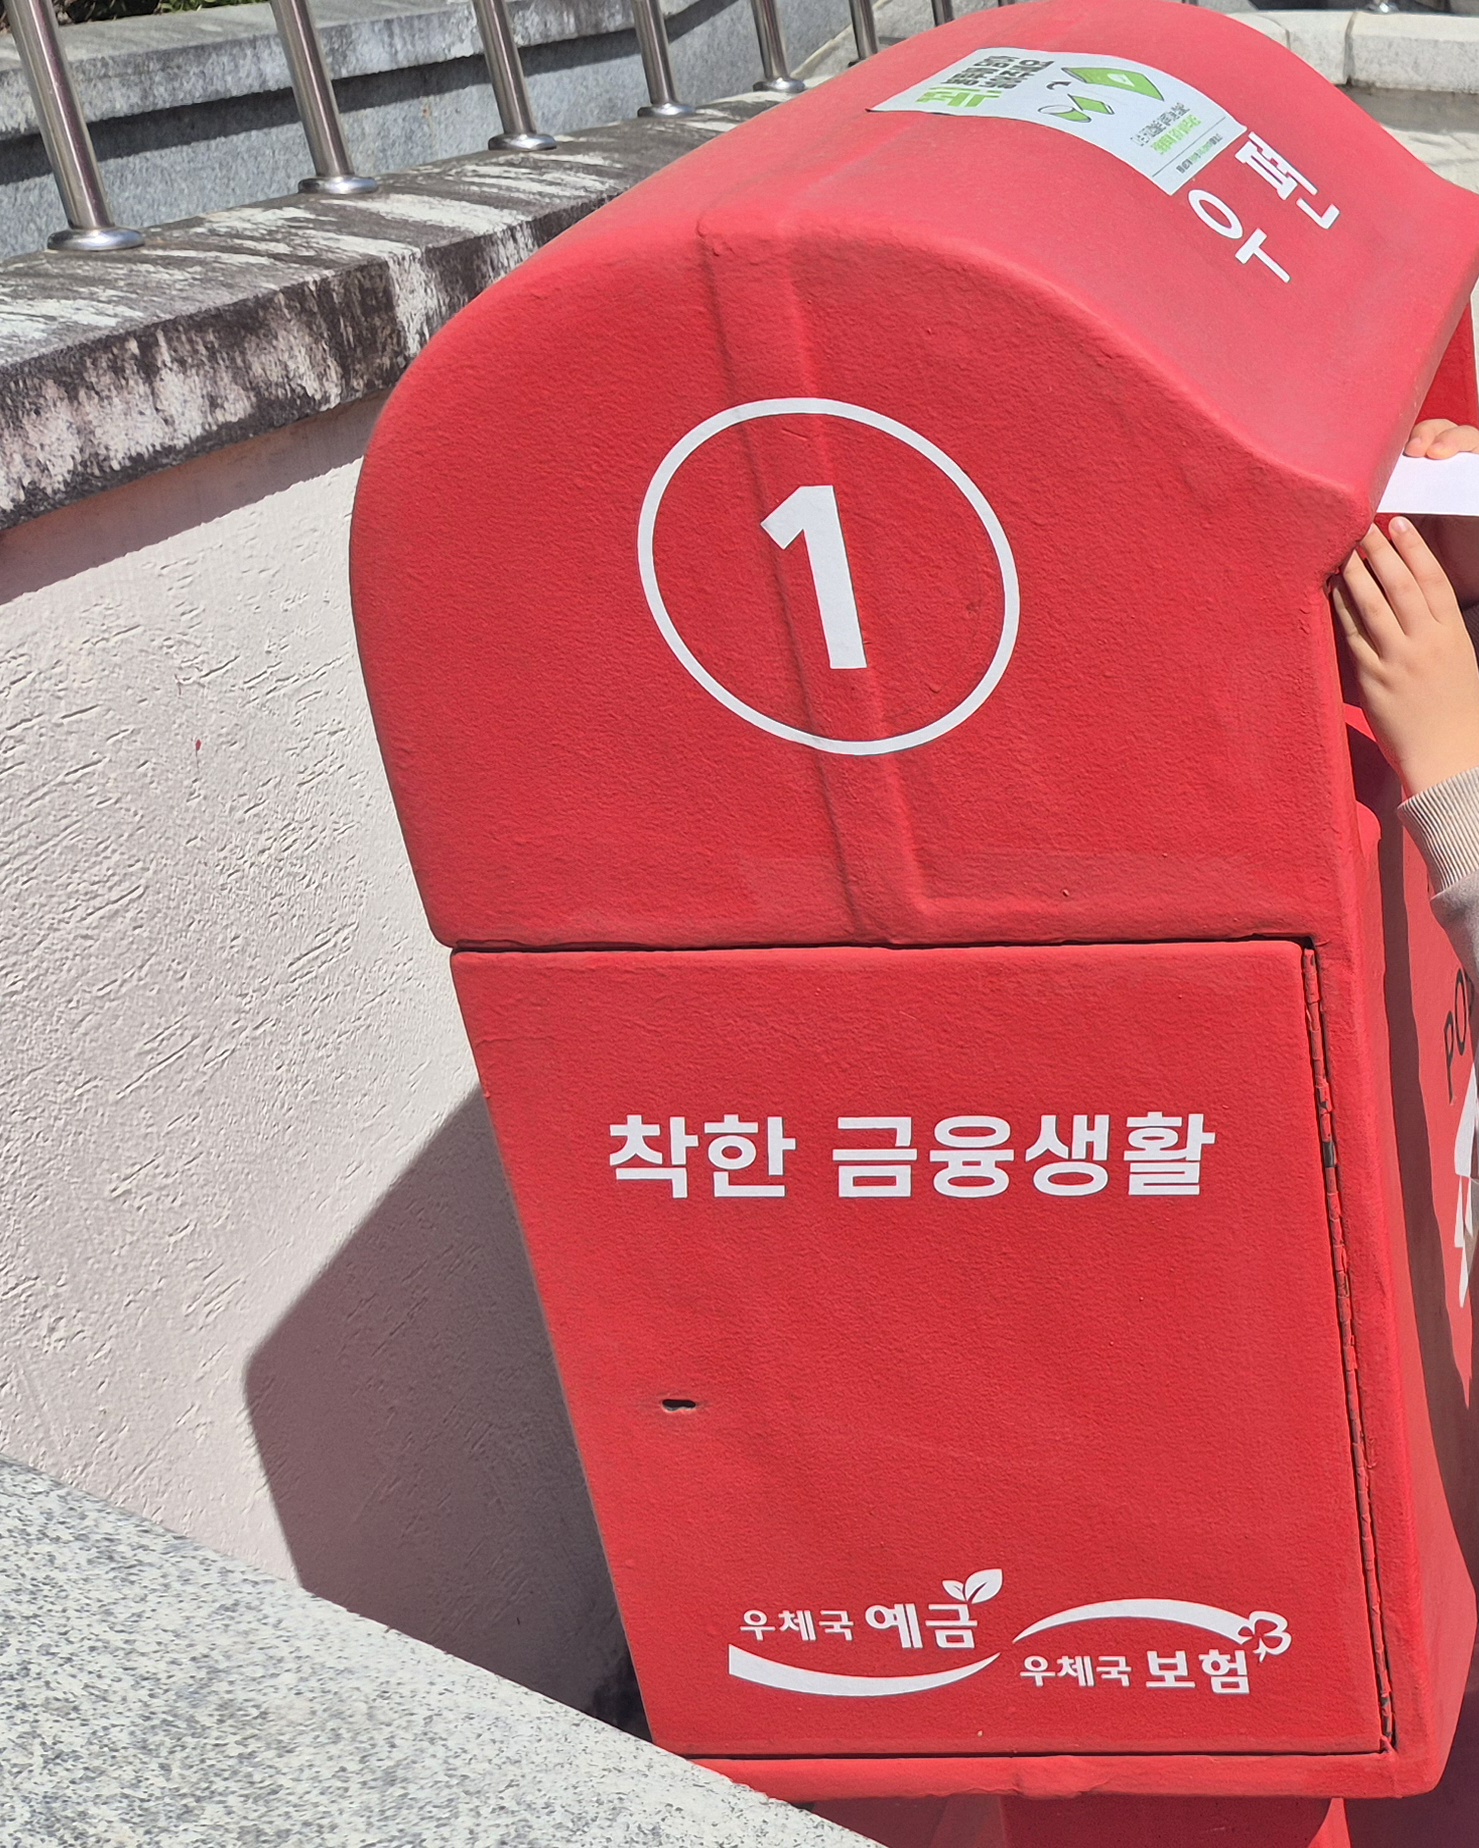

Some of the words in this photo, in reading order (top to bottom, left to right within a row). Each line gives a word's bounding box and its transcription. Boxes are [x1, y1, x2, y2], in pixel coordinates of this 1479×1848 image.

[1188, 131, 1340, 283] 우편
[760, 485, 868, 669] 1
[609, 1114, 797, 1199] 착한
[832, 1112, 1216, 1199] 금융생활
[740, 1609, 854, 1641] 우체국
[865, 1603, 978, 1649] 예금
[1019, 1655, 1132, 1687] 우체국
[1145, 1649, 1250, 1695] 보험
